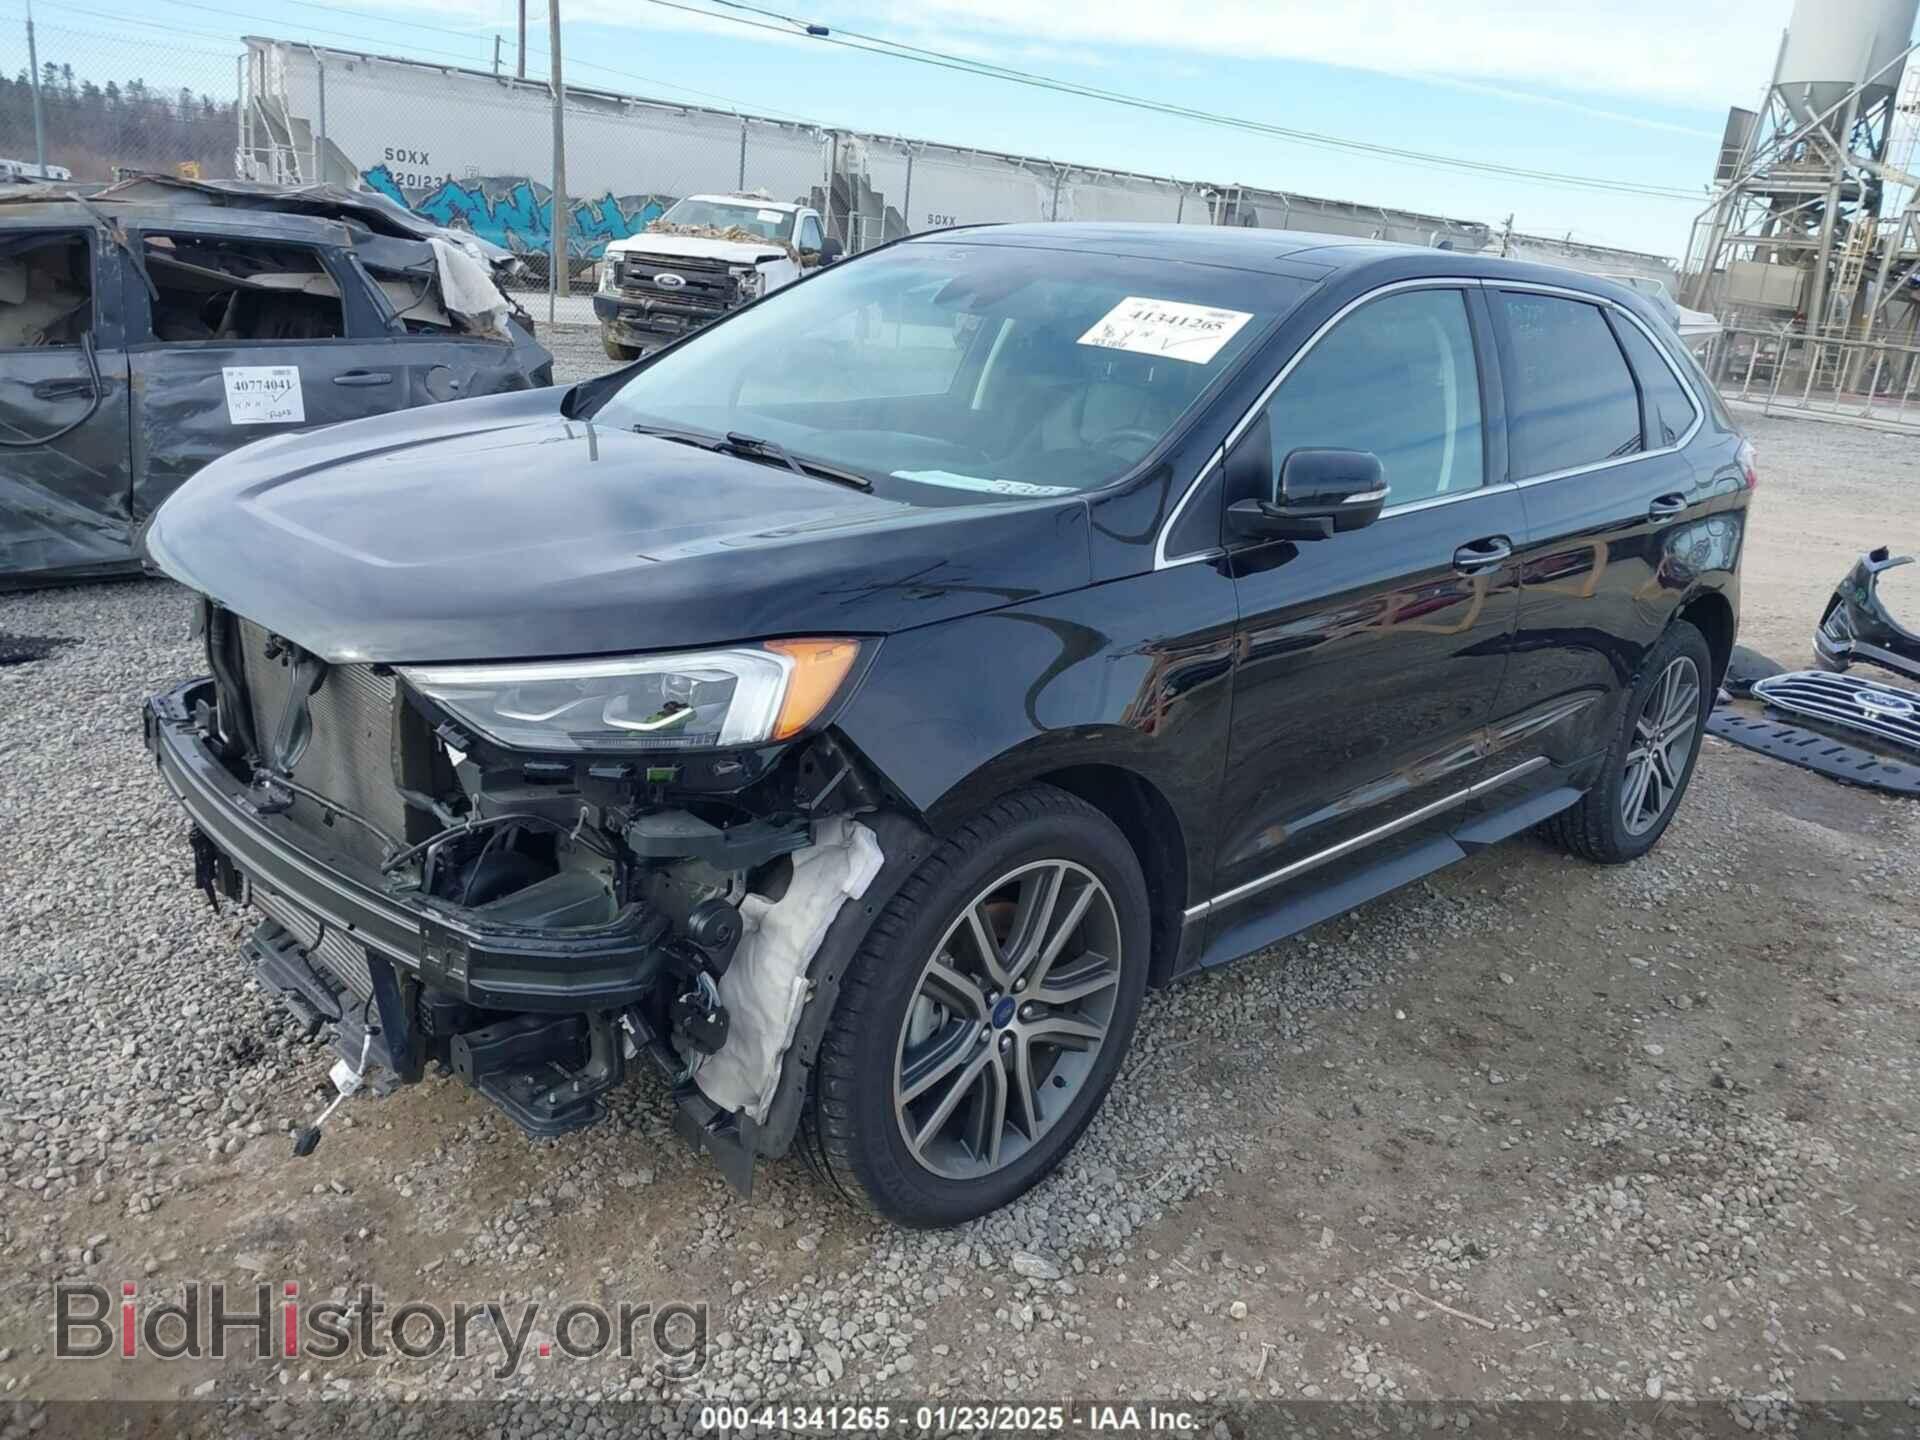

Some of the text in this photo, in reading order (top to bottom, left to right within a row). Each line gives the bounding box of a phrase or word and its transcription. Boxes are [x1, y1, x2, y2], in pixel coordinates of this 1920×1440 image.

[384, 147, 430, 166] SOXX
[927, 214, 957, 226] SOXX
[1128, 310, 1226, 331] 41341265
[233, 379, 291, 392] 40774041
